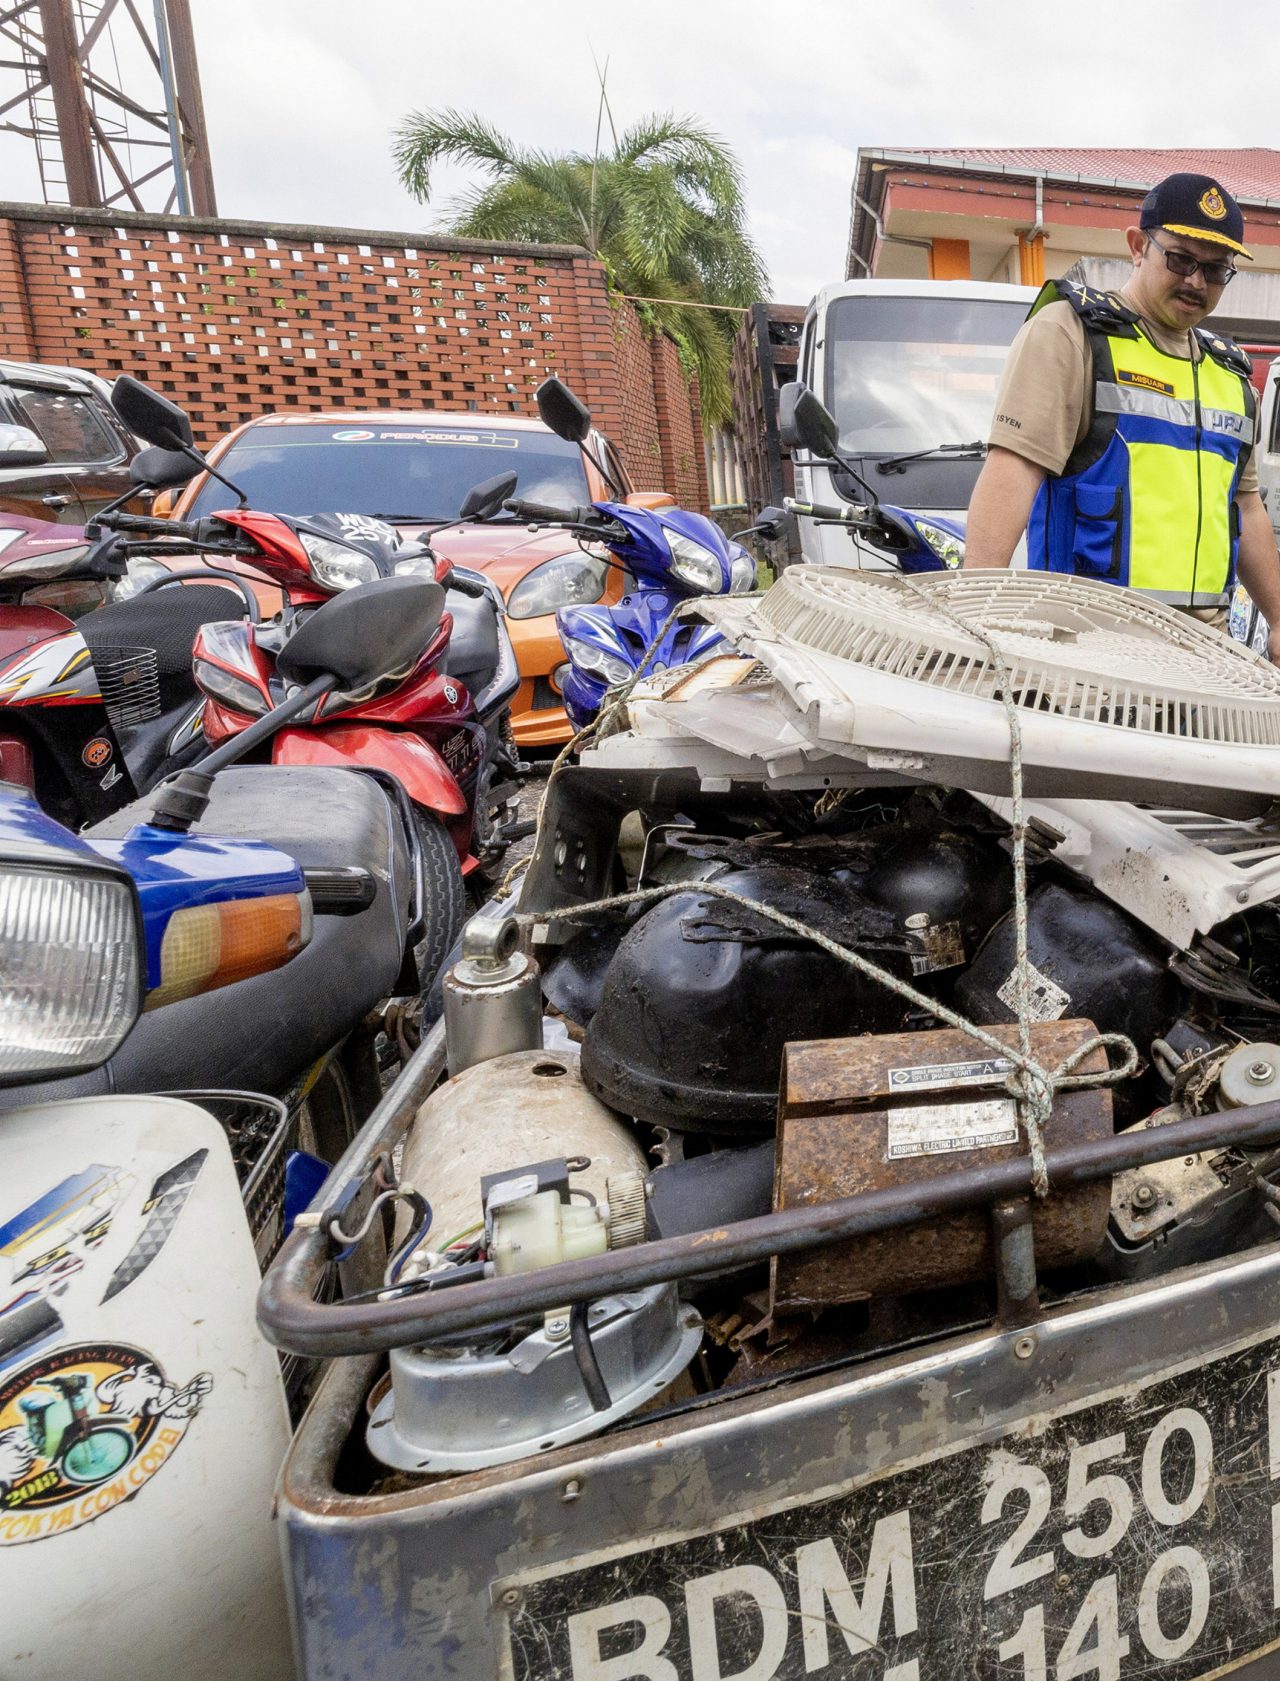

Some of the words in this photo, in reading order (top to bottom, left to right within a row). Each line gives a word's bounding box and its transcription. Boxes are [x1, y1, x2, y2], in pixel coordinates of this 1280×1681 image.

[1131, 374, 1166, 391] MISUARI
[379, 432, 479, 442] PERODUA
[911, 1074, 929, 1082] SPLIT
[893, 1143, 922, 1154] KOSHIWA
[923, 1140, 951, 1150] ELECTRIC
[567, 1509, 919, 1681] BDM
[980, 1407, 1214, 1602] 250
[998, 1545, 1211, 1681] 140
